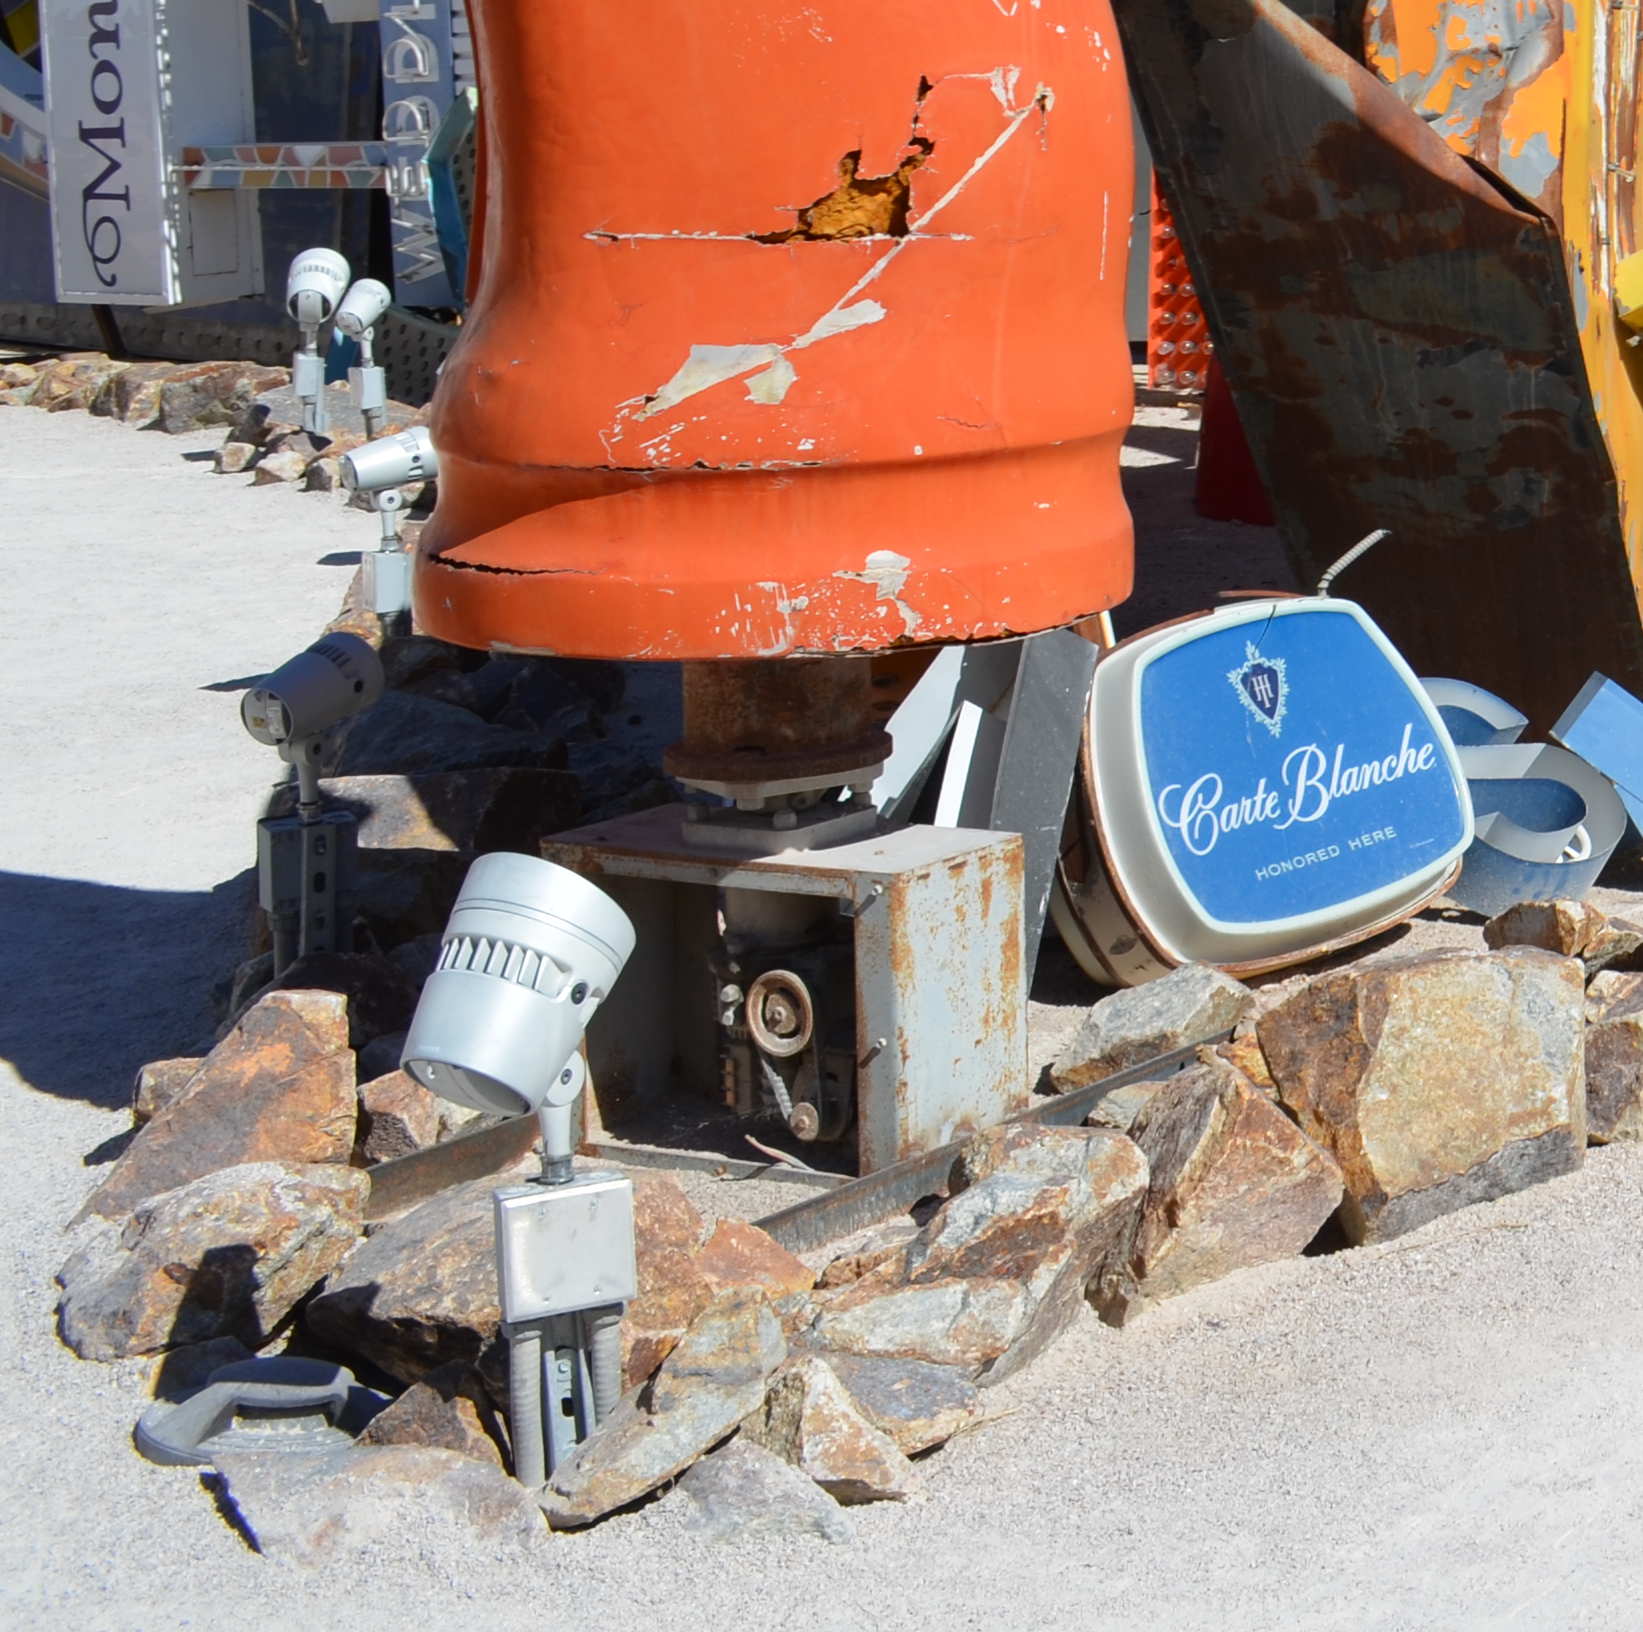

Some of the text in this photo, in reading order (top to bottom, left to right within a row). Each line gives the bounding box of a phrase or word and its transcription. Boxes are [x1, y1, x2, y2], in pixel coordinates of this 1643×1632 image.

[1158, 722, 1437, 856] Carte Blanche
[1254, 825, 1398, 882] HONORED HERE
